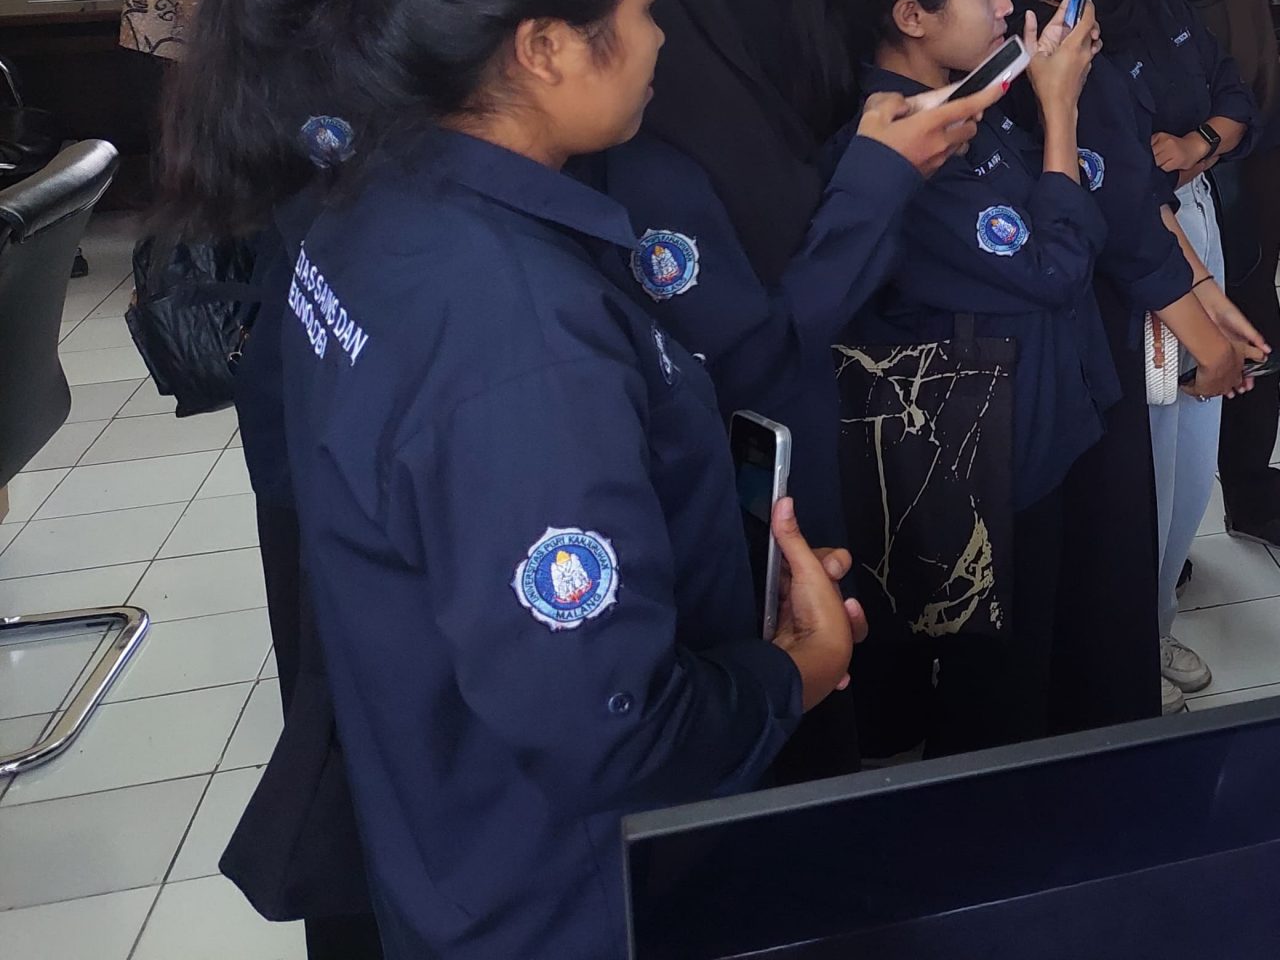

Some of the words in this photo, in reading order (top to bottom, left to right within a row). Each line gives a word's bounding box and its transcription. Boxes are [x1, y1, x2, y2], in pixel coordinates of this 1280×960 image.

[287, 274, 328, 359] EKNOLOGI
[313, 274, 339, 325] SAINS
[333, 307, 369, 364] DAN
[525, 550, 544, 603] UNIVERSITAS
[555, 593, 602, 619] MALANG
